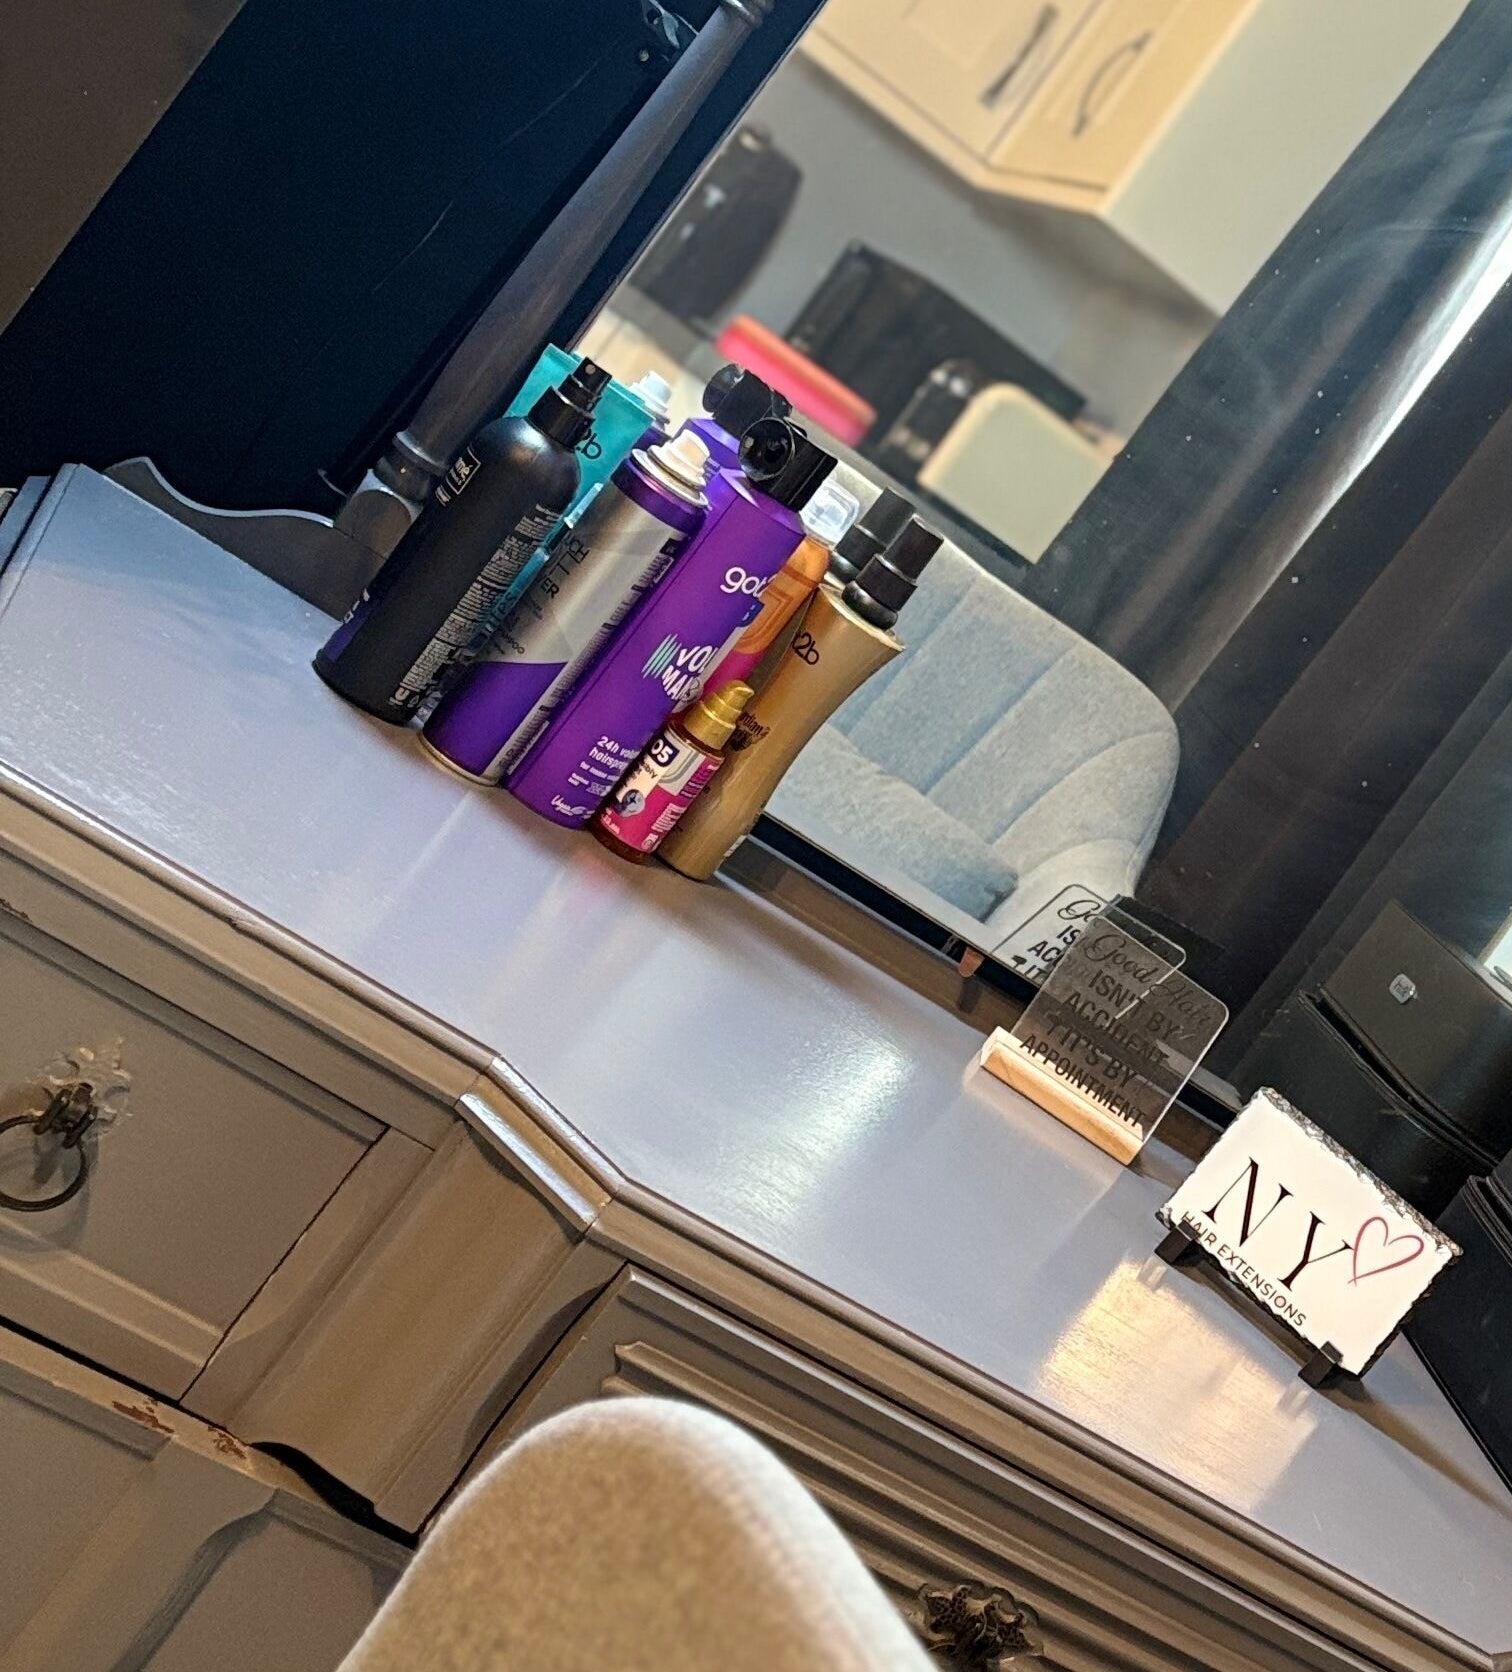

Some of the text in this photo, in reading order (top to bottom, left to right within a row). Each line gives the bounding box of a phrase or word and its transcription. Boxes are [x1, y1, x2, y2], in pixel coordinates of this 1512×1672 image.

[651, 739, 674, 764] 05
[1083, 933, 1212, 1023] Good Hair
[1088, 971, 1182, 1043] ISN'T BY
[1064, 1024, 1137, 1089] IT'S BY
[1066, 991, 1169, 1065] ACCIDENT
[1019, 1033, 1148, 1129] APPOINTMENT
[1181, 1210, 1307, 1327] HAIR EXTENSIONS
